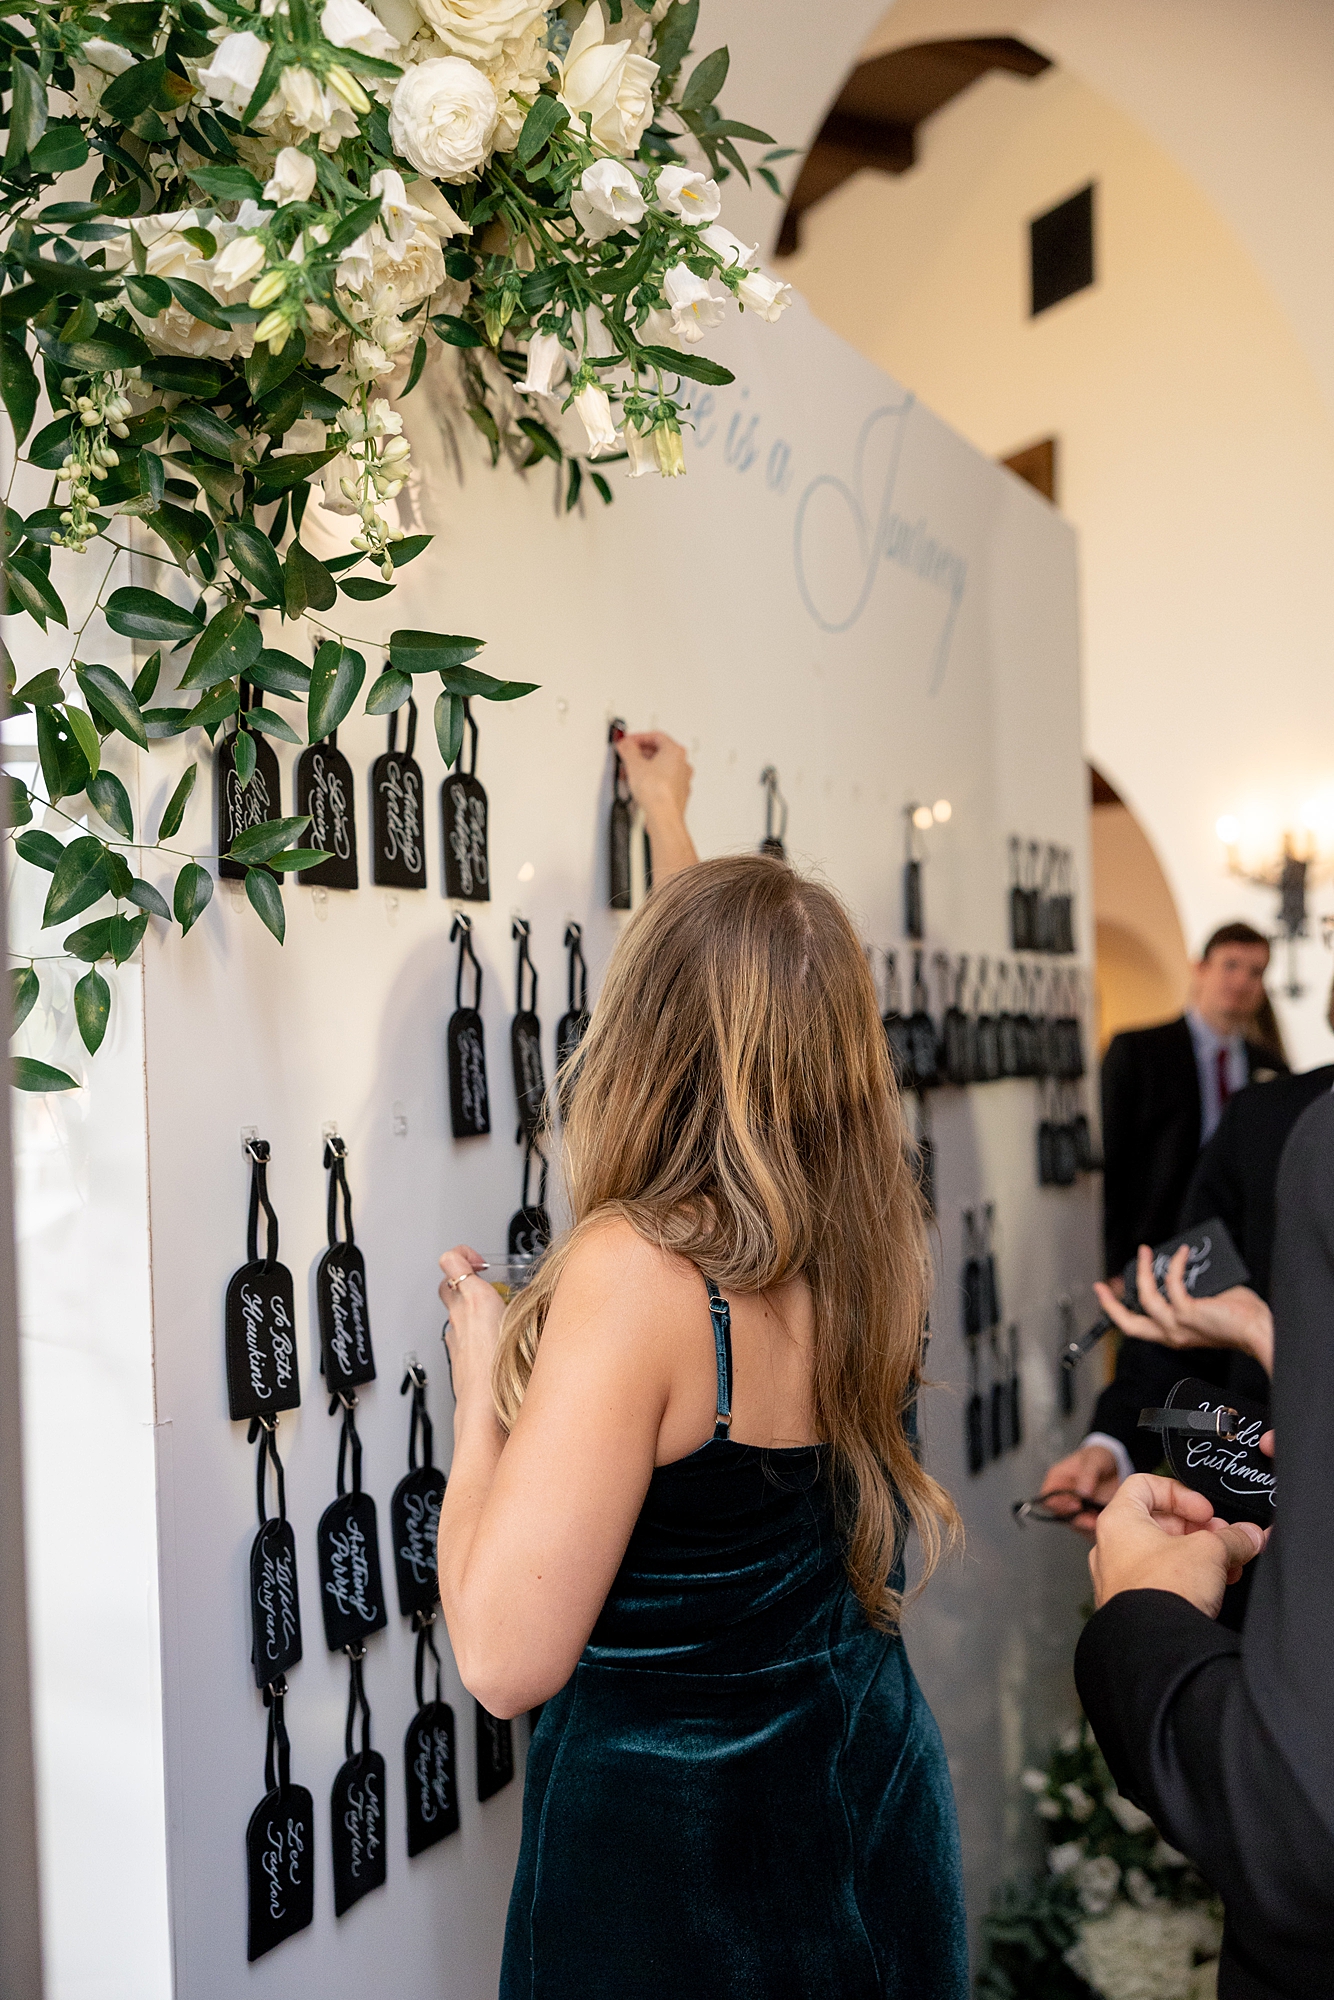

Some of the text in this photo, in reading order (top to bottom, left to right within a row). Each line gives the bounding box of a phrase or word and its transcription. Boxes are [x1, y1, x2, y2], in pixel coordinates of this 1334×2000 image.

[402, 770, 423, 874] Anthony
[240, 1283, 272, 1400] Hawkins
[269, 1325, 293, 1389] Beth
[326, 1262, 353, 1376] Holiday
[347, 1269, 370, 1366] Sharon
[325, 1531, 351, 1616] Perry
[345, 1516, 378, 1622] Anthony
[400, 1493, 428, 1584] Perry
[256, 1535, 280, 1661] Morgan
[275, 1545, 296, 1651] Will
[286, 1817, 305, 1886] Lee
[343, 1782, 365, 1878] Taylor
[363, 1772, 382, 1861] Mark
[261, 1820, 287, 1920] Taylor
